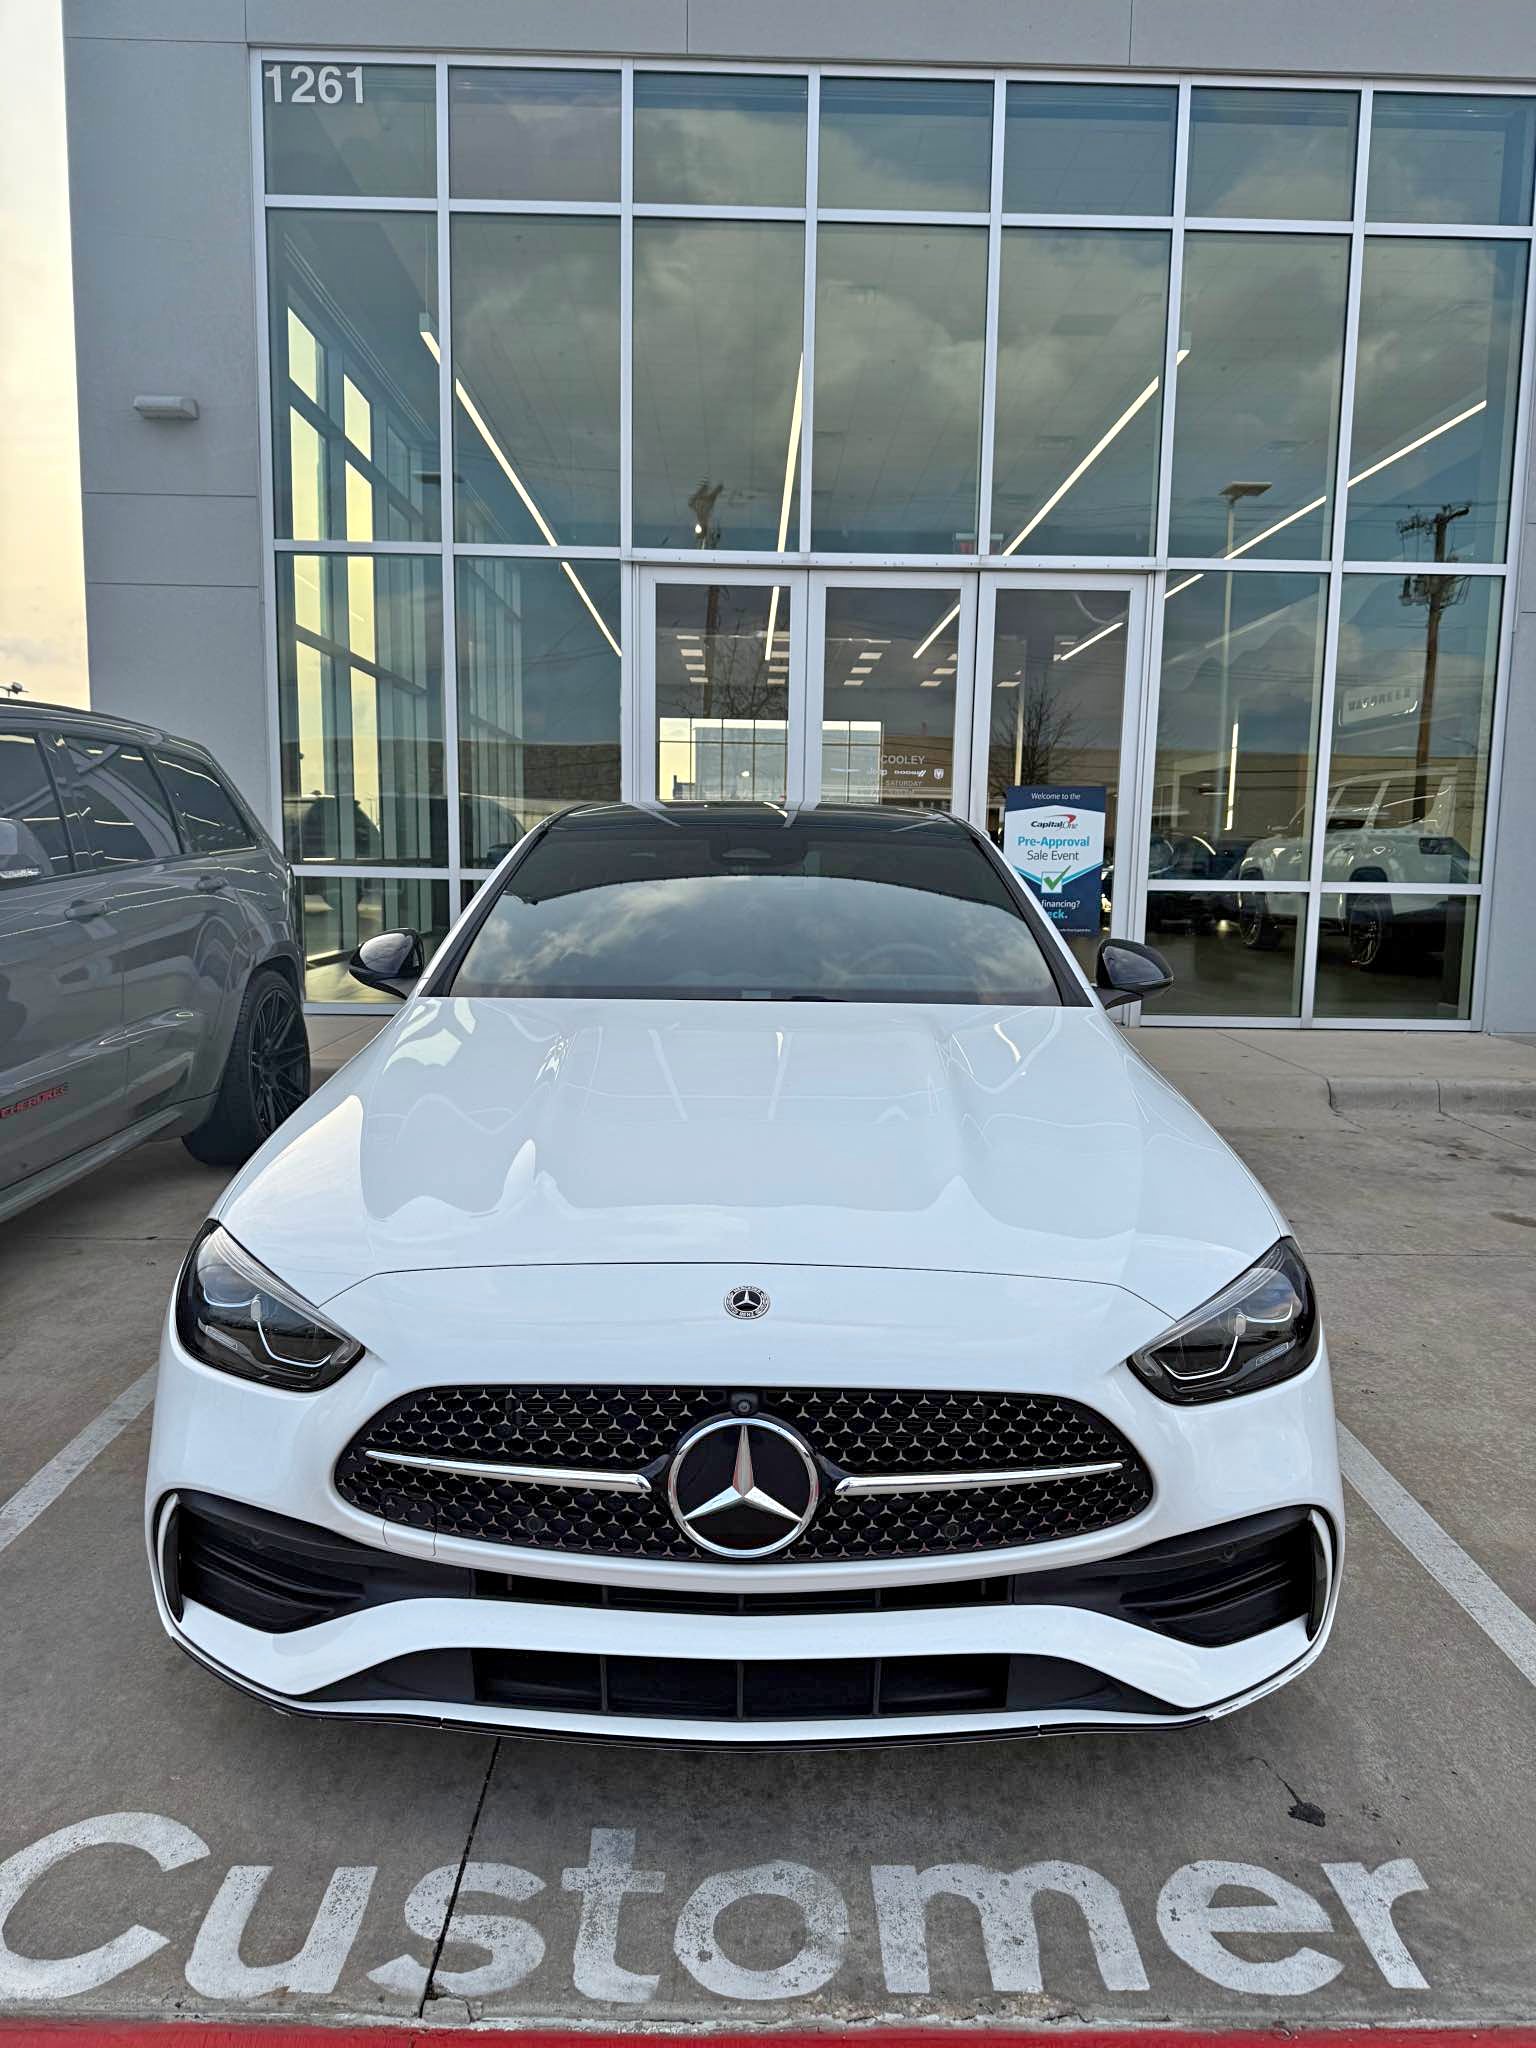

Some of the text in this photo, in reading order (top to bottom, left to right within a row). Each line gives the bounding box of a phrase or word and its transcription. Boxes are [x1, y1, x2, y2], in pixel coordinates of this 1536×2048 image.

[265, 65, 364, 104] 1261
[880, 755, 925, 765] COOLEY
[1031, 792, 1081, 801] Welcome to the
[1017, 836, 1090, 849] Pre-Approval
[1026, 850, 1080, 861] Sale Event
[0, 1811, 1429, 2003] Customer
